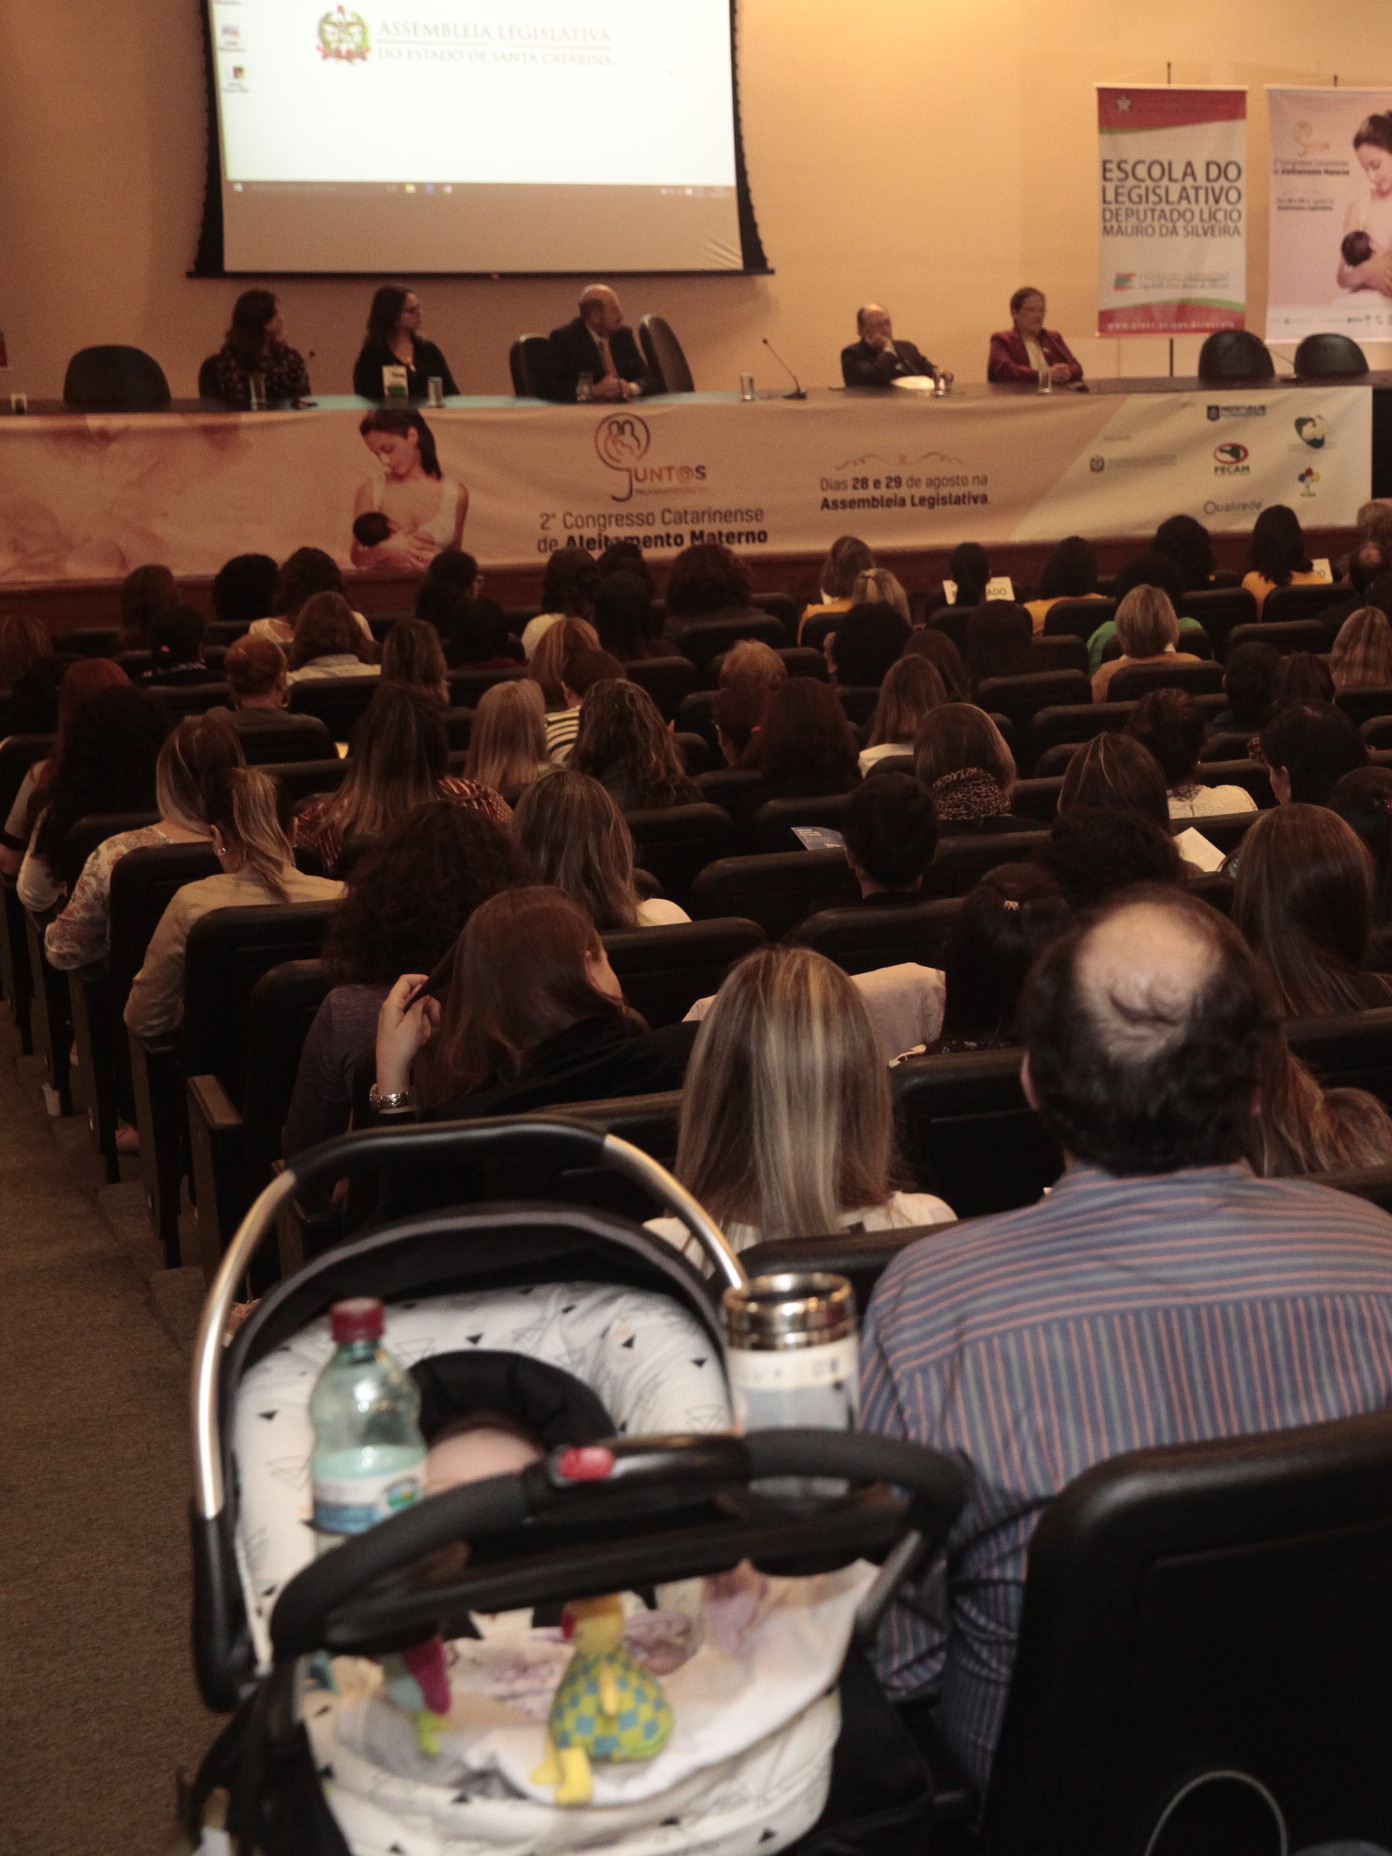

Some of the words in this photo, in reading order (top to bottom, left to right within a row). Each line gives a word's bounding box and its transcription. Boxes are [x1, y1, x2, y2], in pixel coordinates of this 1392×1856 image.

[379, 21, 493, 39] ASSEMBLEIA
[498, 24, 612, 43] LEGISLATIVA
[378, 47, 402, 60] DO
[407, 48, 464, 62] ESTADO
[469, 50, 488, 63] DE
[492, 51, 539, 65] SANTA
[542, 52, 614, 67] CATARINA
[1102, 159, 1197, 183] ESCOLA
[1205, 159, 1242, 183] DO
[1102, 184, 1242, 206] LEGISLATIVO
[1102, 206, 1195, 223] DEPUTADO
[1199, 205, 1242, 223] LÍCIO
[1102, 223, 1156, 237] MAURO
[1159, 223, 1179, 237] DA
[1182, 223, 1241, 237] SILVEIRA
[1214, 465, 1250, 475] FECAM
[820, 477, 848, 492] Dias
[852, 476, 869, 490] 28
[873, 478, 882, 490] e
[885, 475, 902, 490] 29
[906, 475, 922, 489] de
[925, 474, 969, 490] agosto
[972, 474, 988, 487] na
[820, 493, 907, 511] Assembleia
[911, 491, 988, 509] Legislativa
[562, 510, 656, 533] Congresso
[661, 506, 765, 527] Catarinense
[537, 537, 559, 554] de
[690, 529, 768, 545] Materno
